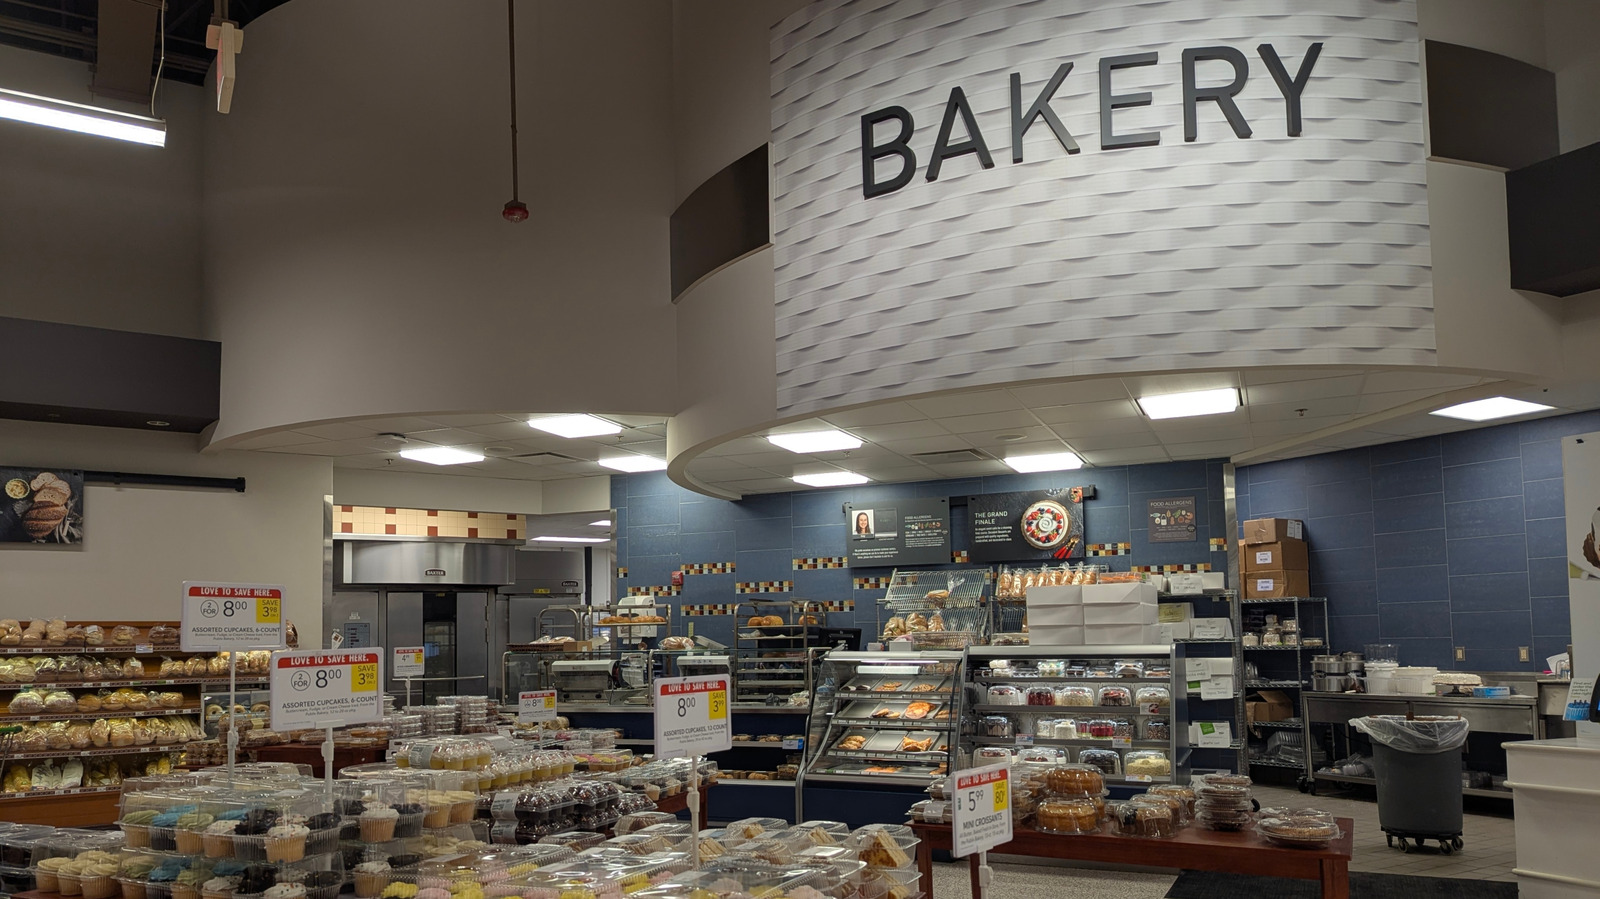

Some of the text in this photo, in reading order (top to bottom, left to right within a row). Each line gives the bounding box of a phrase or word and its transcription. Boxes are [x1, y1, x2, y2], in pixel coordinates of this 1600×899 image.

[861, 42, 1324, 200] BAKERY
[291, 657, 310, 665] LOVE
[327, 655, 345, 663] SAVE
[349, 654, 369, 662] HERE.
[668, 681, 720, 692] LOVE TO SAVE HERE.
[282, 700, 316, 708] ASSORTED
[316, 698, 349, 706] CUPCAKES,
[664, 728, 685, 736] ASSORTED
[961, 777, 971, 786] LOVE
[980, 773, 990, 782] SAVE
[990, 770, 1001, 779] HERE.
[963, 812, 1002, 830] MINI CROISSANTS
